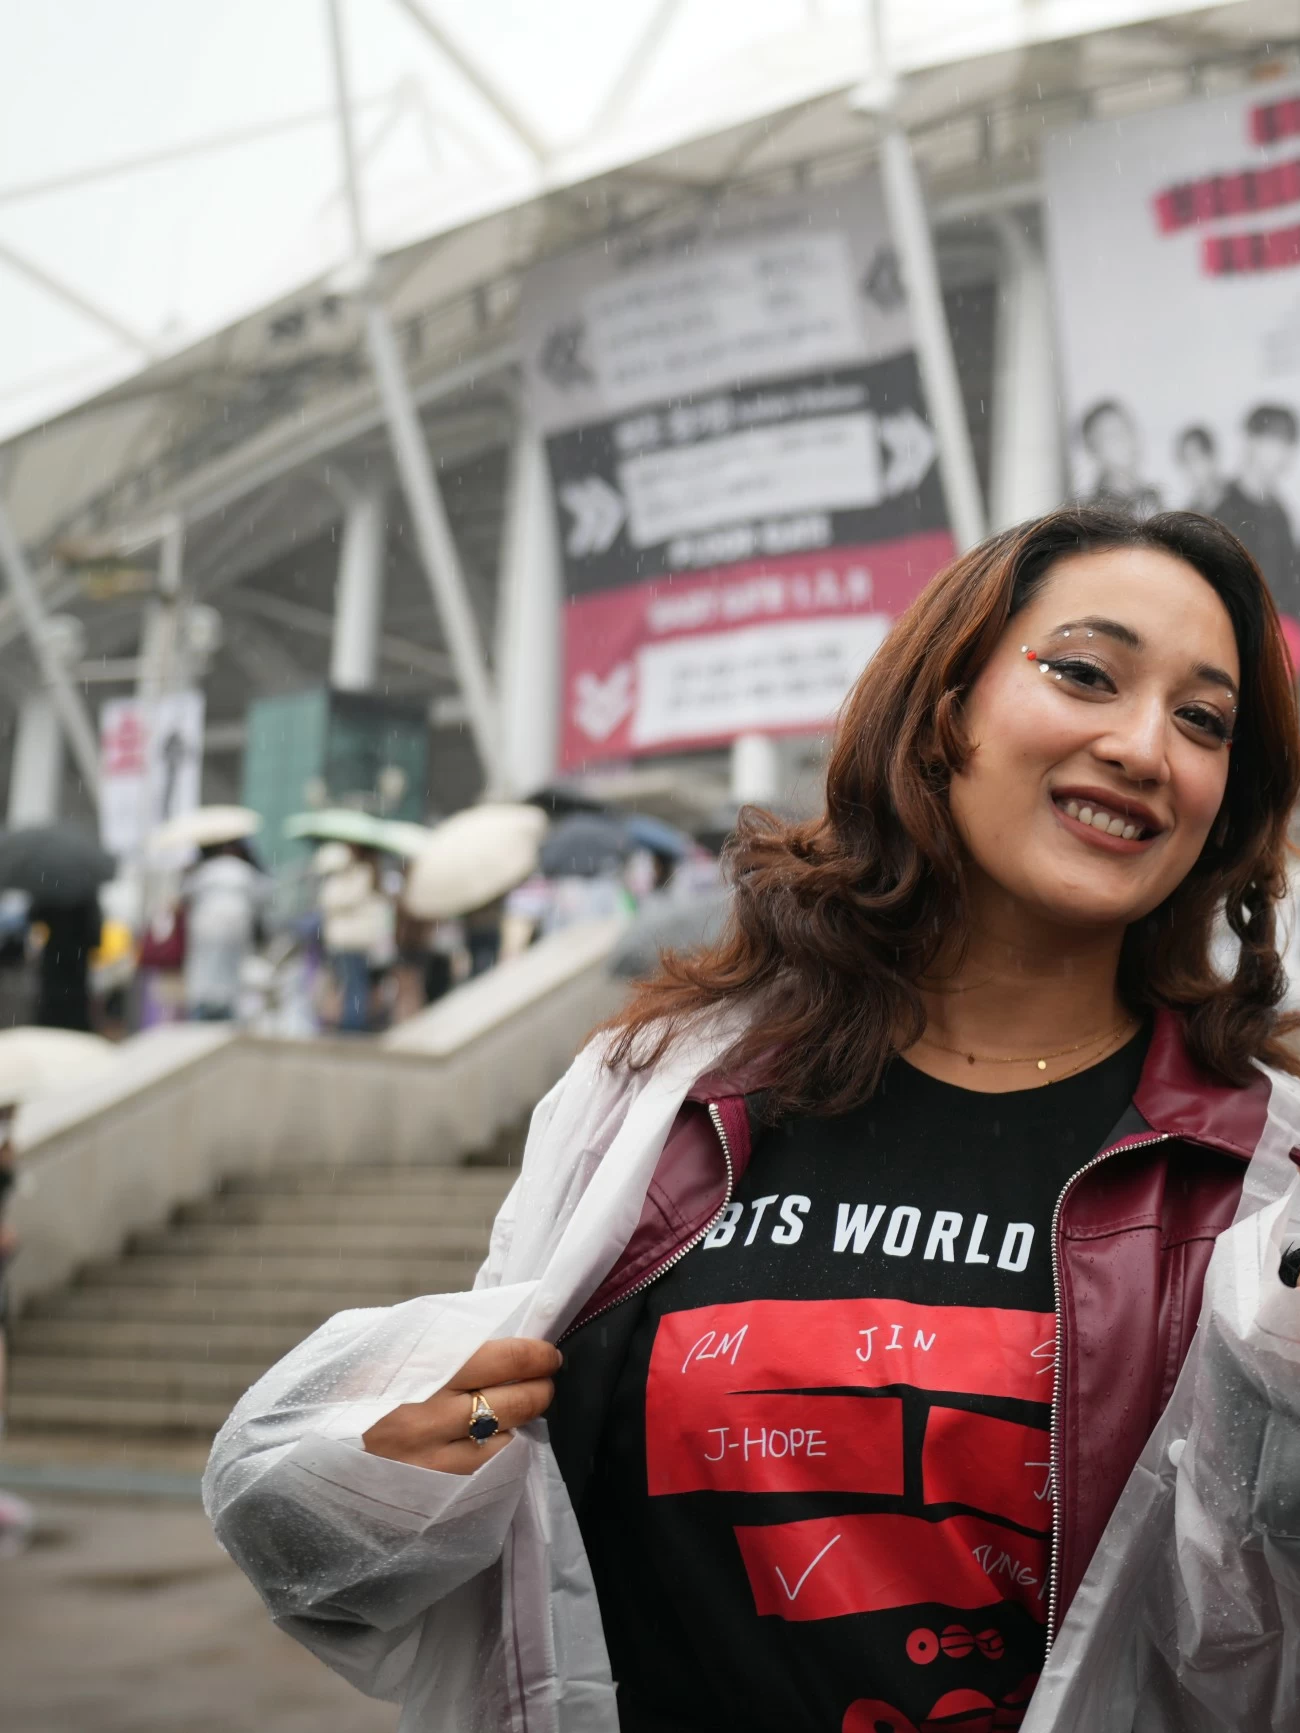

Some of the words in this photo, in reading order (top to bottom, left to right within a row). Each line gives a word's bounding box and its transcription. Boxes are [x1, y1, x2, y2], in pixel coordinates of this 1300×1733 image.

[703, 1194, 812, 1250] BTS
[833, 1203, 1035, 1273] WORLD
[855, 1324, 937, 1363] JIN
[704, 1427, 828, 1462] J-HOPE
